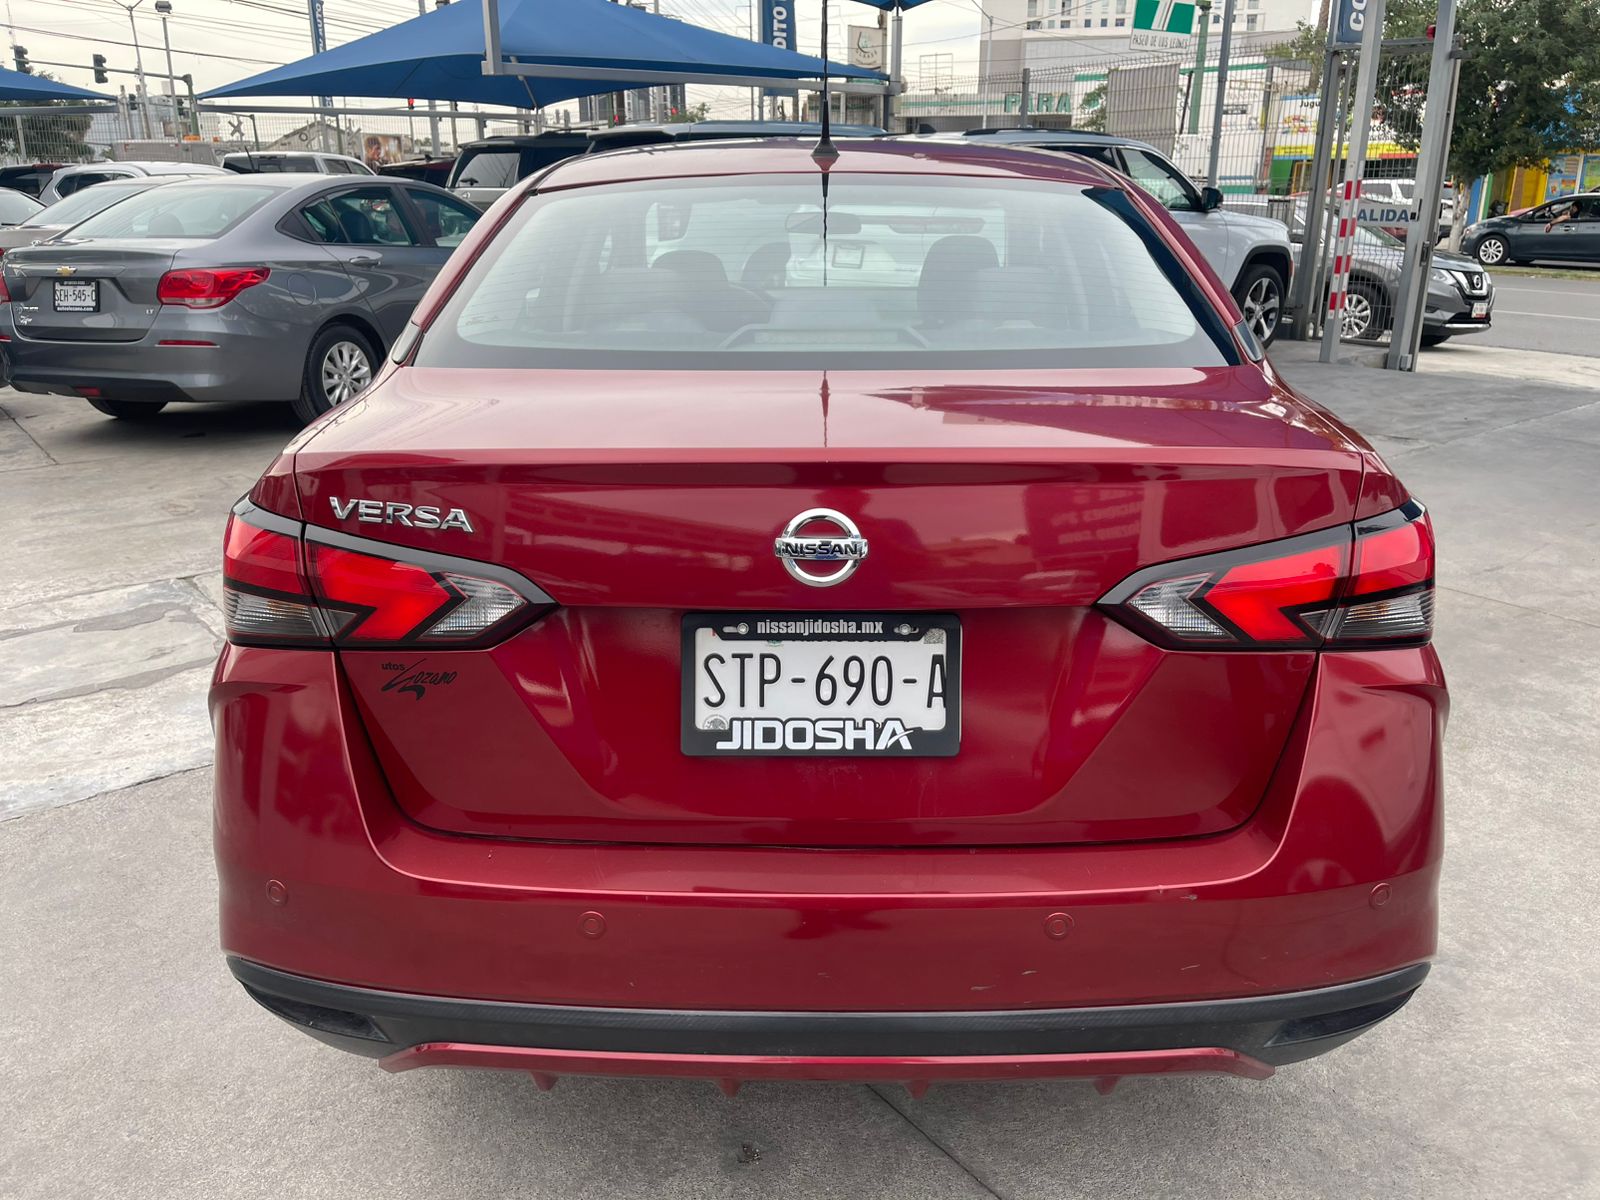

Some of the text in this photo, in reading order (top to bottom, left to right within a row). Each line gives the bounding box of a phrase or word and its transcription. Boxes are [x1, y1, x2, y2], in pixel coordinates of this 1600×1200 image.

[328, 495, 474, 534] VERSA
[783, 542, 859, 556] NISSAN
[757, 620, 884, 637] nissanjidosha.mx
[703, 652, 947, 709] STP-690-A
[716, 717, 914, 751] JIDOSHA
